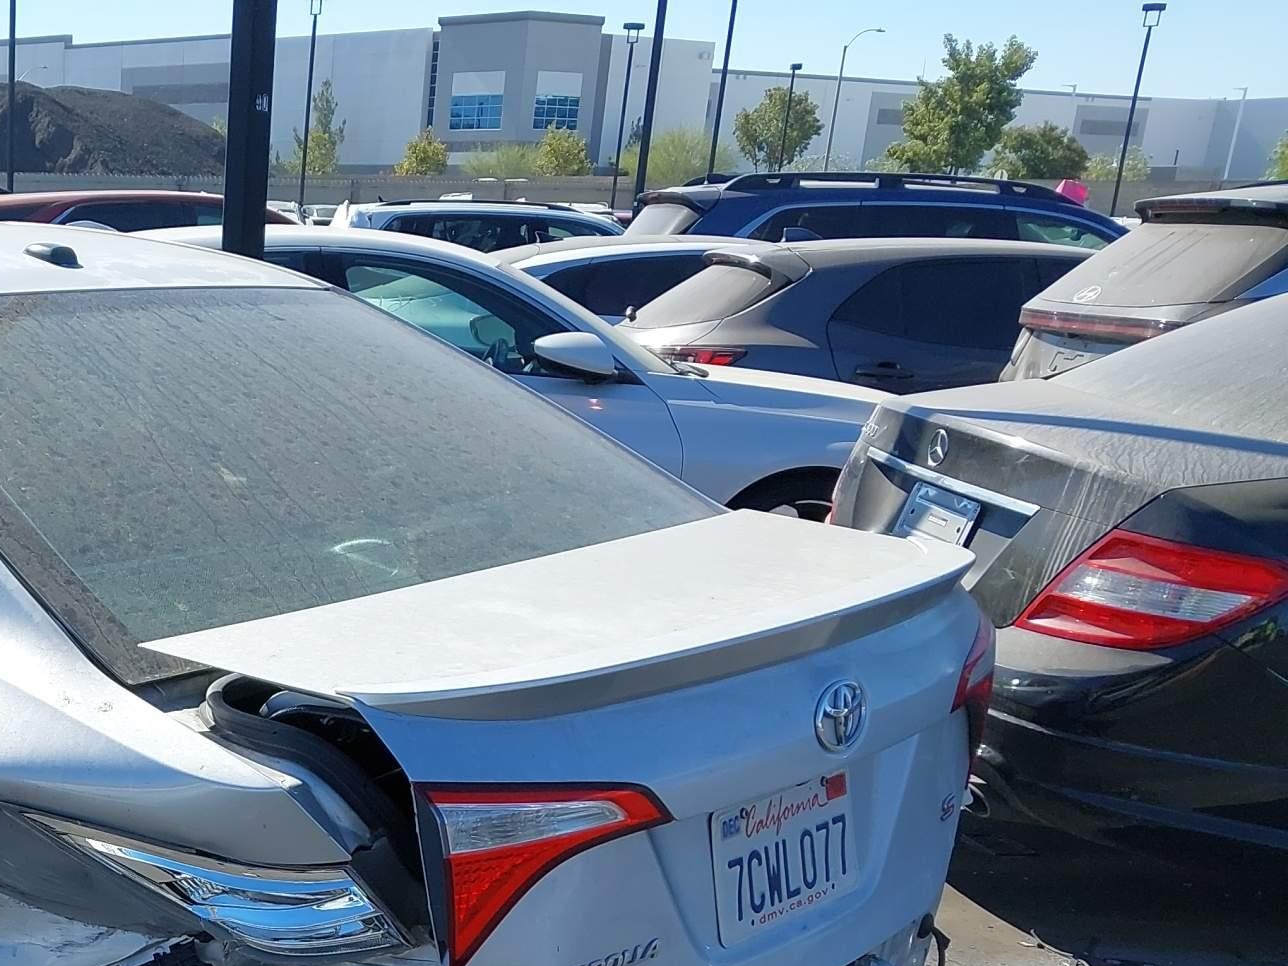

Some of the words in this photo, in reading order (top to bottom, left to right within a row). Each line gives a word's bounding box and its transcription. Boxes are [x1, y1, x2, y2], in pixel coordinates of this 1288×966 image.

[721, 815, 741, 839] DEC
[744, 794, 829, 839] California
[727, 813, 847, 922] 7CWL077
[759, 887, 829, 925] dmv.ca.gov
